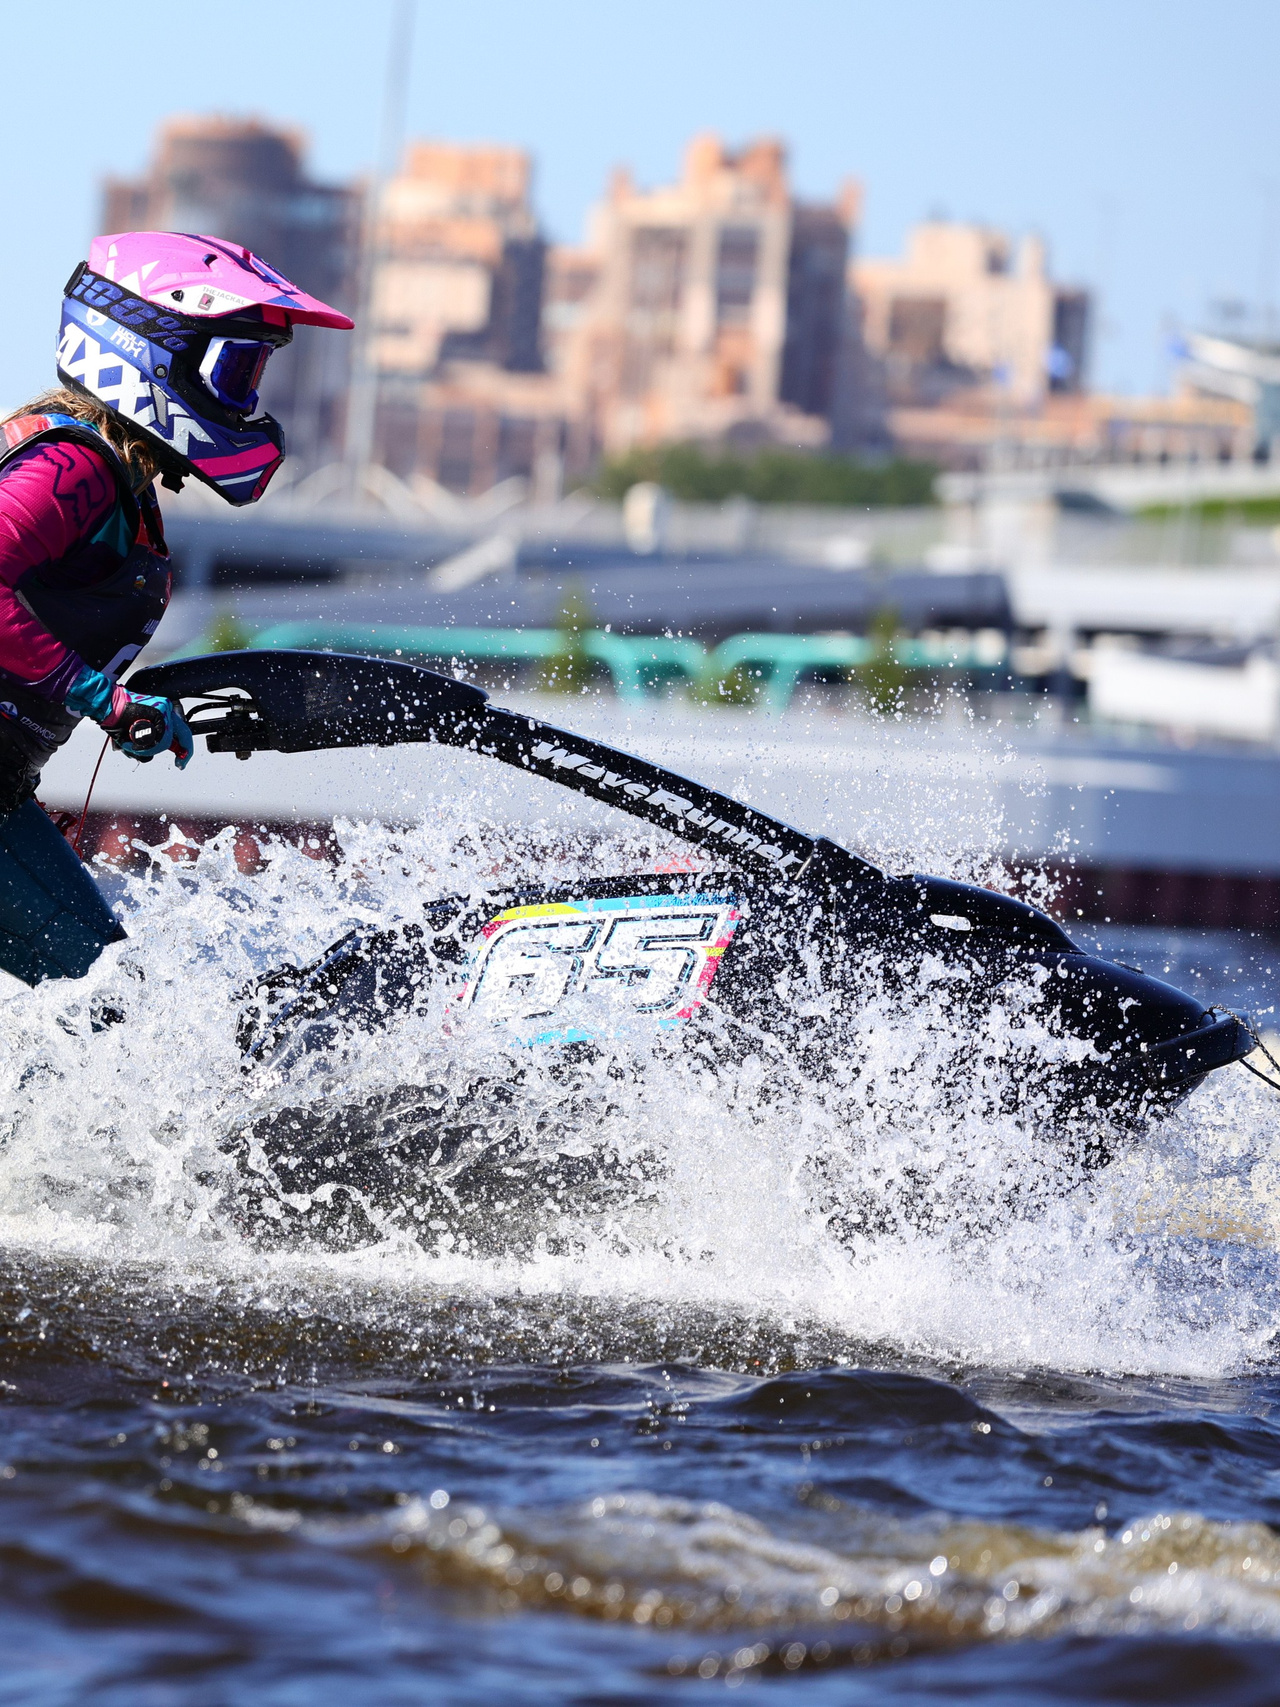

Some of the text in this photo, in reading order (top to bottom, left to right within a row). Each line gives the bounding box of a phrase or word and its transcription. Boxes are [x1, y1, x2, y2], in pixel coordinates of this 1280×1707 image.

[72, 273, 198, 352] 100%
[118, 326, 147, 348] WOLF
[530, 741, 803, 868] WaveRunner
[470, 912, 719, 1024] 65
